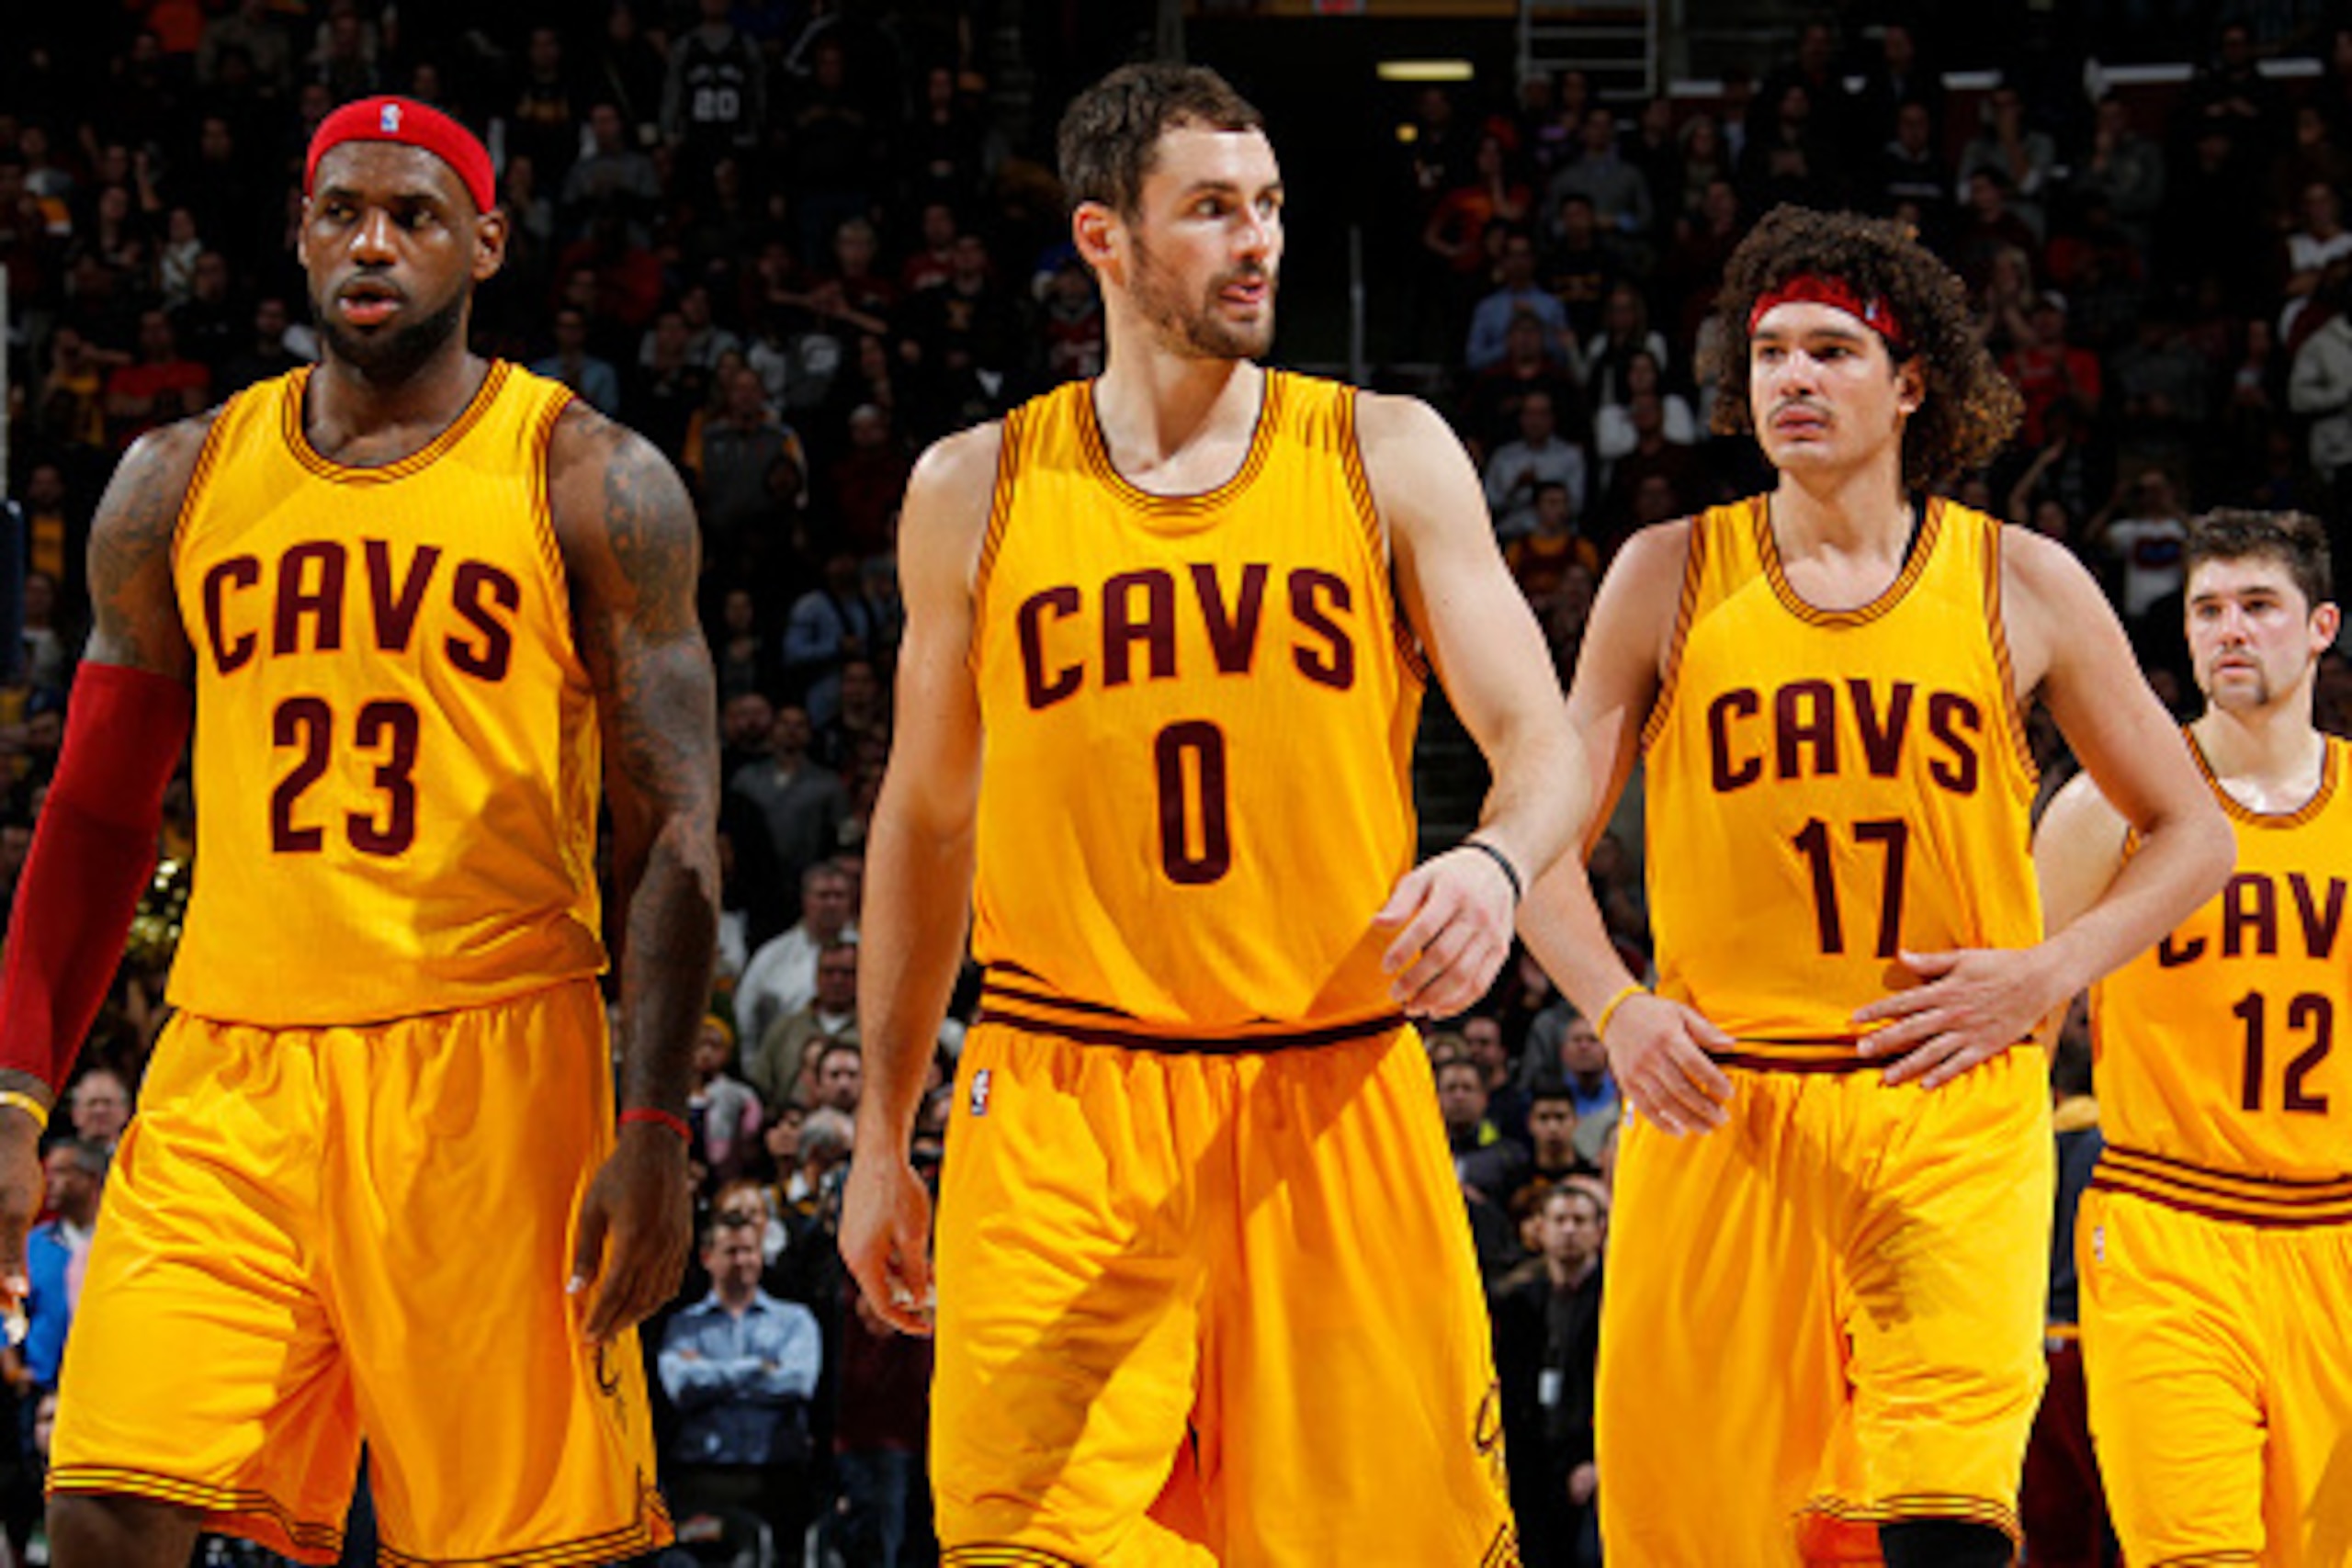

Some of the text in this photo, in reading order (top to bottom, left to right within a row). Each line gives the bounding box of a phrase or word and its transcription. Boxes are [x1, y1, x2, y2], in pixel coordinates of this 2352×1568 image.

[202, 538, 522, 682] CAVS
[1015, 562, 1355, 711] CAVS
[270, 695, 421, 858] 23
[1153, 718, 1232, 886] 0
[1706, 678, 1982, 795] CAVS
[1792, 816, 1910, 960] 17
[2232, 989, 2334, 1114] 12
